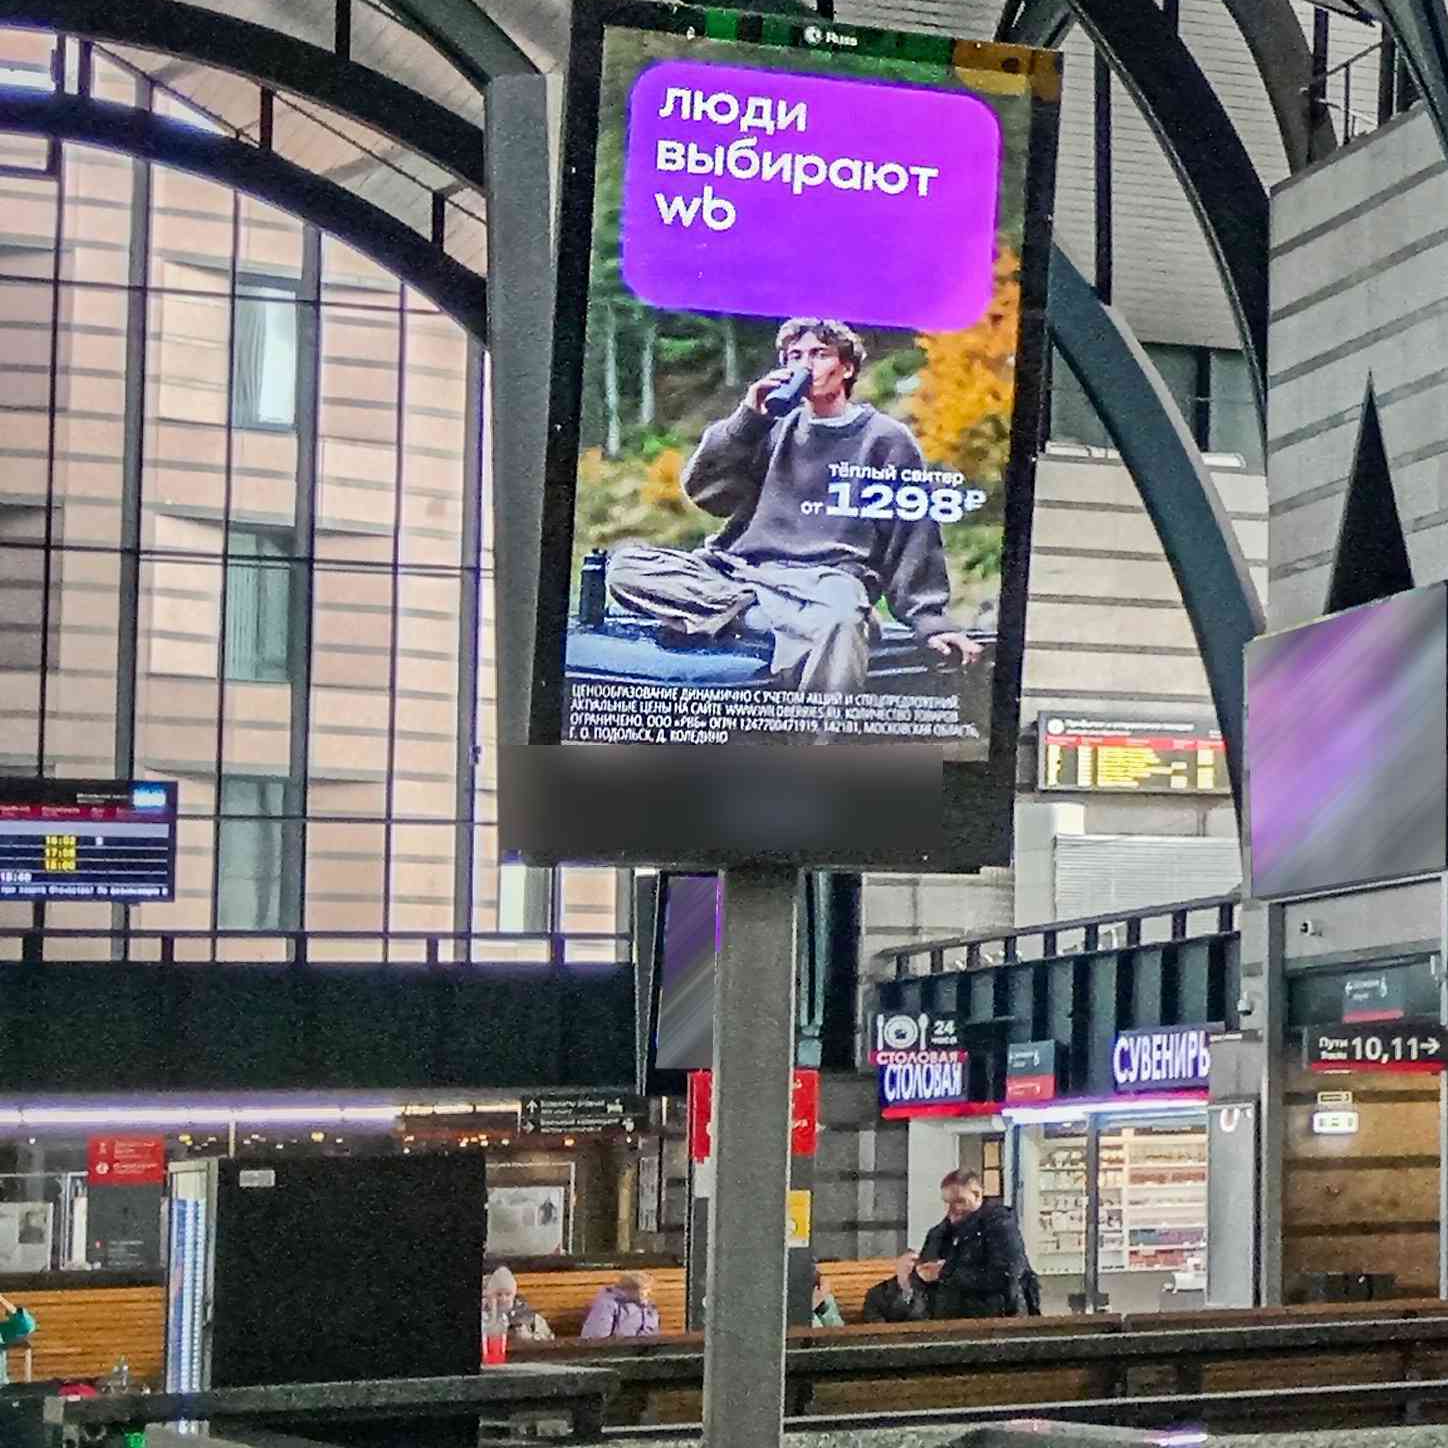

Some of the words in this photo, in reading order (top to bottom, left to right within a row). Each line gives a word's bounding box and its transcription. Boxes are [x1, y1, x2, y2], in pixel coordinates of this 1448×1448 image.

[659, 87, 807, 135] люди
[656, 136, 939, 197] выбирают
[654, 184, 736, 231] wb
[828, 462, 896, 481] тёплый
[900, 469, 965, 487] свитер
[801, 500, 823, 515] от
[572, 684, 678, 700] ЦЕНООБРАЗОВАНИЕ
[640, 701, 672, 715] ЦЕНЫ
[646, 715, 672, 728] ООО
[933, 1019, 956, 1035] 24
[877, 1051, 958, 1065] СТОЛОВАЯ
[1352, 1036, 1418, 1064] 10,11
[884, 1062, 962, 1101] СТОЛОВАЯ
